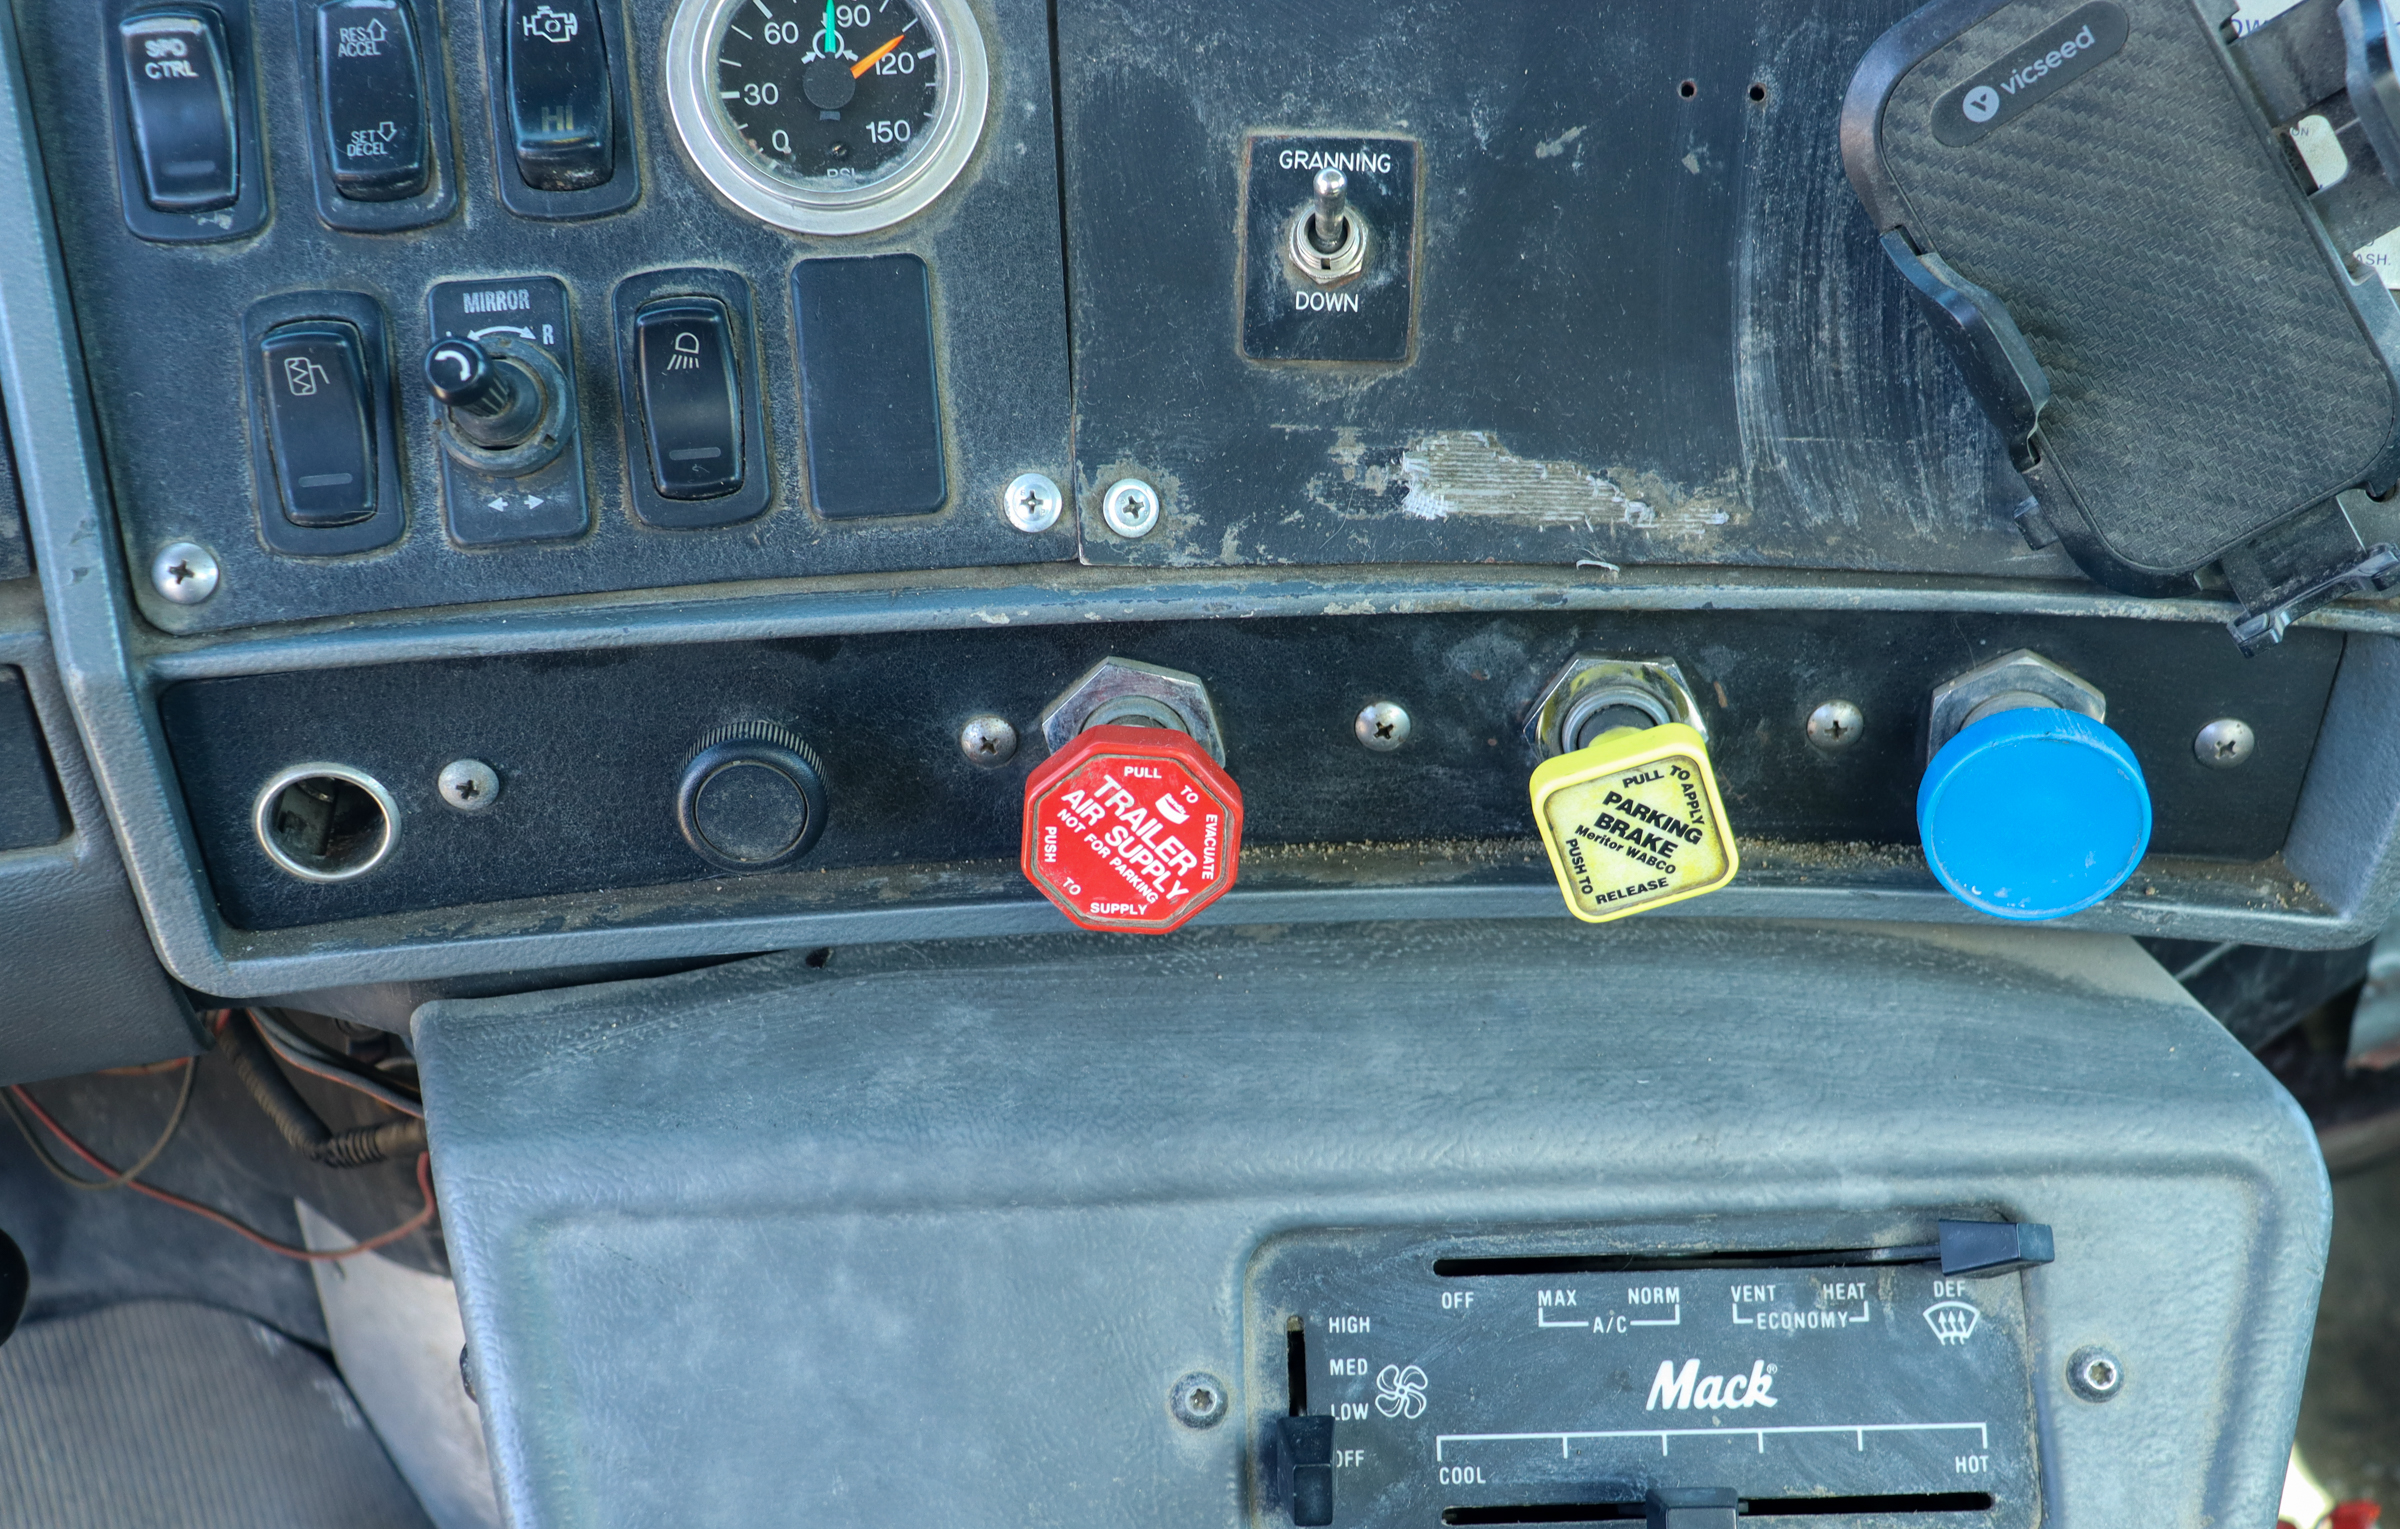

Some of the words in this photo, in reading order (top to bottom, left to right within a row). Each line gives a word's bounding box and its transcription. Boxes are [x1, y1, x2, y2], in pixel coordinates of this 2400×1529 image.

[836, 4, 871, 28] 90
[764, 22, 799, 45] 60
[144, 38, 188, 58] SPD
[338, 41, 382, 57] ACCEL
[2001, 24, 2096, 95] vicseed
[144, 60, 199, 80] CTRL
[875, 51, 915, 75] 120
[743, 83, 779, 106] 30
[541, 105, 574, 131] HI
[351, 129, 376, 144] SET
[771, 130, 790, 152] 0
[865, 119, 911, 144] 150
[347, 142, 388, 157] DECEL
[1279, 150, 1391, 173] GRANNING
[463, 289, 531, 313] MIRROR
[1295, 291, 1359, 312] DOWN
[542, 324, 555, 345] R
[1622, 769, 1665, 788] PULL
[1670, 765, 1690, 781] TO
[1681, 783, 1706, 826] APPLY
[1093, 774, 1198, 877] TRAILER
[1124, 766, 1162, 779] PULL
[1180, 784, 1199, 803] TO
[1201, 814, 1218, 880] EVACUATE
[1602, 790, 1703, 845] PARKING
[1061, 789, 1106, 826] AIR
[1104, 825, 1190, 900] SUPPLY
[1593, 812, 1679, 859] BRAKE
[1057, 808, 1087, 833] NOT
[1084, 833, 1111, 859] FOR
[1109, 857, 1159, 904] PARKING
[1574, 825, 1624, 852] Meritor
[1625, 846, 1677, 875] WABCO
[1044, 826, 1057, 863] PUSH
[1063, 877, 1082, 896] TO
[1090, 902, 1148, 916] SUPPLY
[1566, 838, 1588, 874] PUSH
[1579, 876, 1594, 895] TO
[1595, 877, 1669, 905] RELEASE
[1441, 1291, 1475, 1309] OFF
[1538, 1289, 1577, 1306] MAX
[1628, 1286, 1680, 1304] NORM
[1731, 1284, 1776, 1302] VENT
[1822, 1282, 1866, 1300] HEAT
[1933, 1280, 1966, 1297] DEF
[1329, 1316, 1370, 1333] HIGH
[1593, 1315, 1627, 1334] A/C
[1757, 1310, 1849, 1330] ECONOMY
[1329, 1358, 1368, 1376] MED
[1330, 1402, 1369, 1421] LOW
[1439, 1466, 1486, 1485] COOL
[1955, 1454, 1989, 1474] HOT
